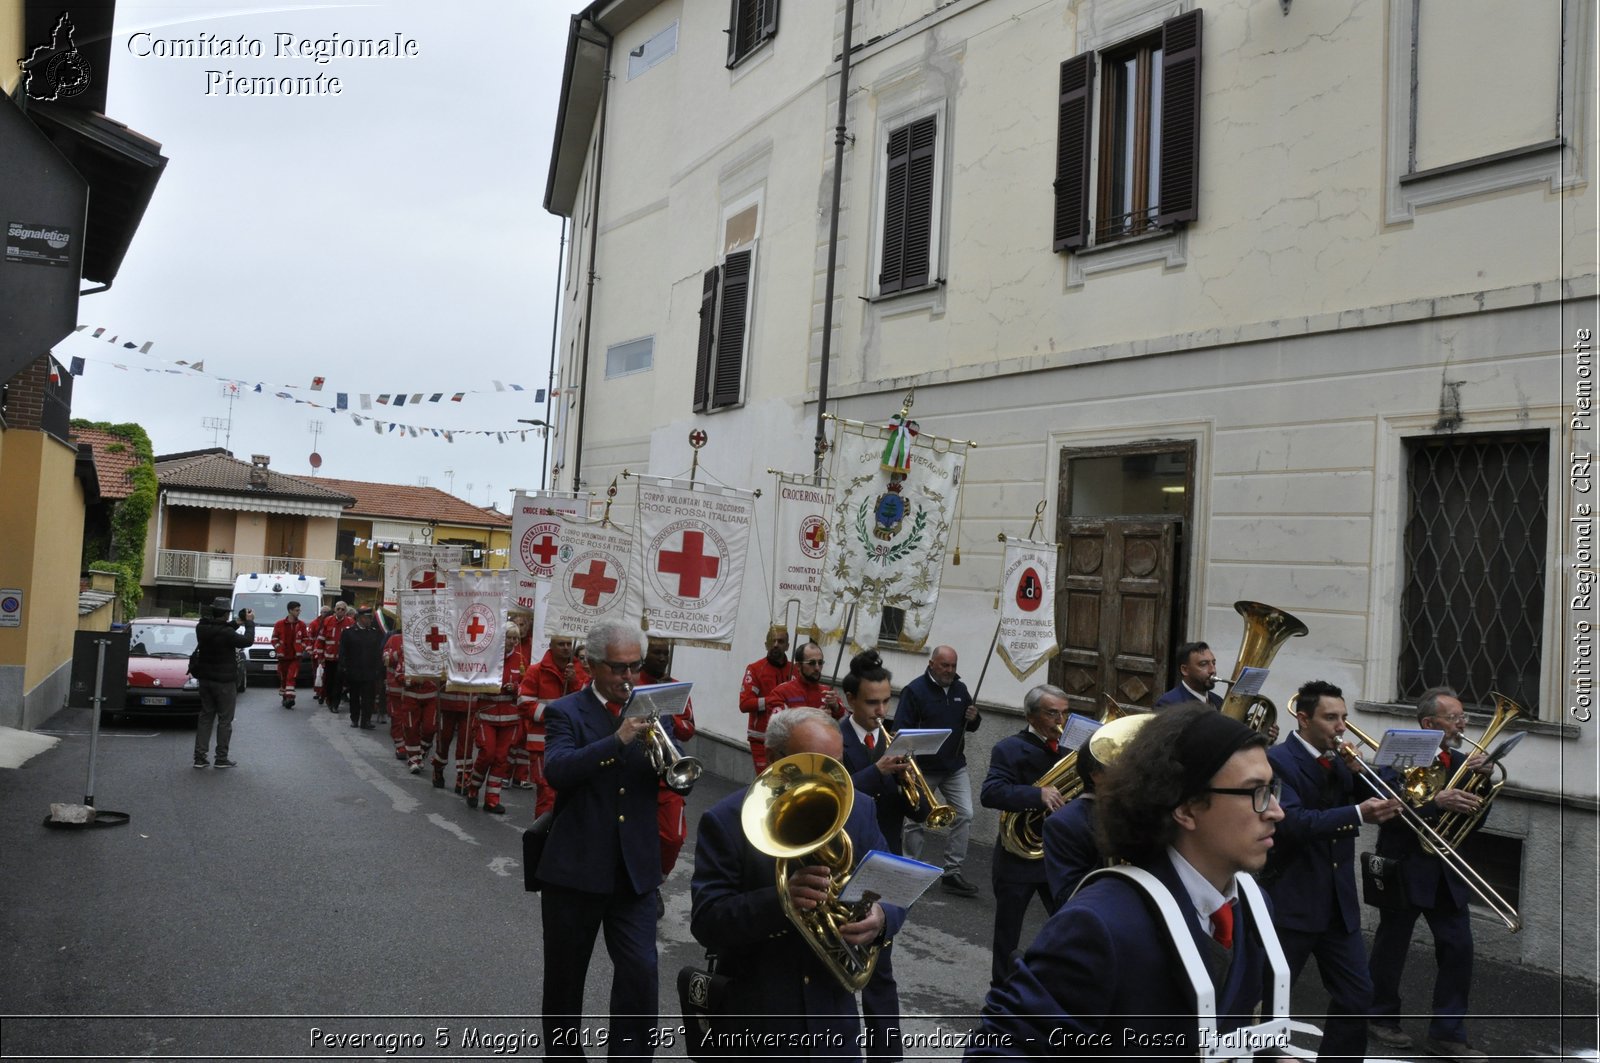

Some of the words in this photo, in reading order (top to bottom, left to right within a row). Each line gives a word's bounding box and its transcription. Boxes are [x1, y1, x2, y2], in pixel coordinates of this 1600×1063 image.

[8, 228, 70, 242] segnaletica
[909, 453, 949, 480] EVERAGNO
[643, 491, 664, 503] CORPO
[667, 494, 701, 507] VOLONTARI
[703, 500, 713, 510] DEL
[716, 502, 745, 514] SOCCORSO
[782, 487, 804, 502] CROCE
[805, 490, 824, 505] ROSSA
[523, 506, 538, 515] CROCE
[639, 502, 671, 515] CROCE
[675, 507, 706, 518] ROSSA
[709, 511, 749, 525] ITALIANA
[522, 525, 552, 554] CONVENZIONE
[560, 535, 585, 546] CROCE
[587, 541, 611, 551] ROSSA
[652, 520, 699, 551] CONVENZIONE
[708, 528, 728, 559] GINEVRA
[787, 566, 816, 575] COMITATO
[645, 608, 710, 623] DELEGAZIONE
[713, 614, 722, 624] DI
[562, 622, 590, 633] MORE
[647, 618, 718, 635] PEVERAGNO
